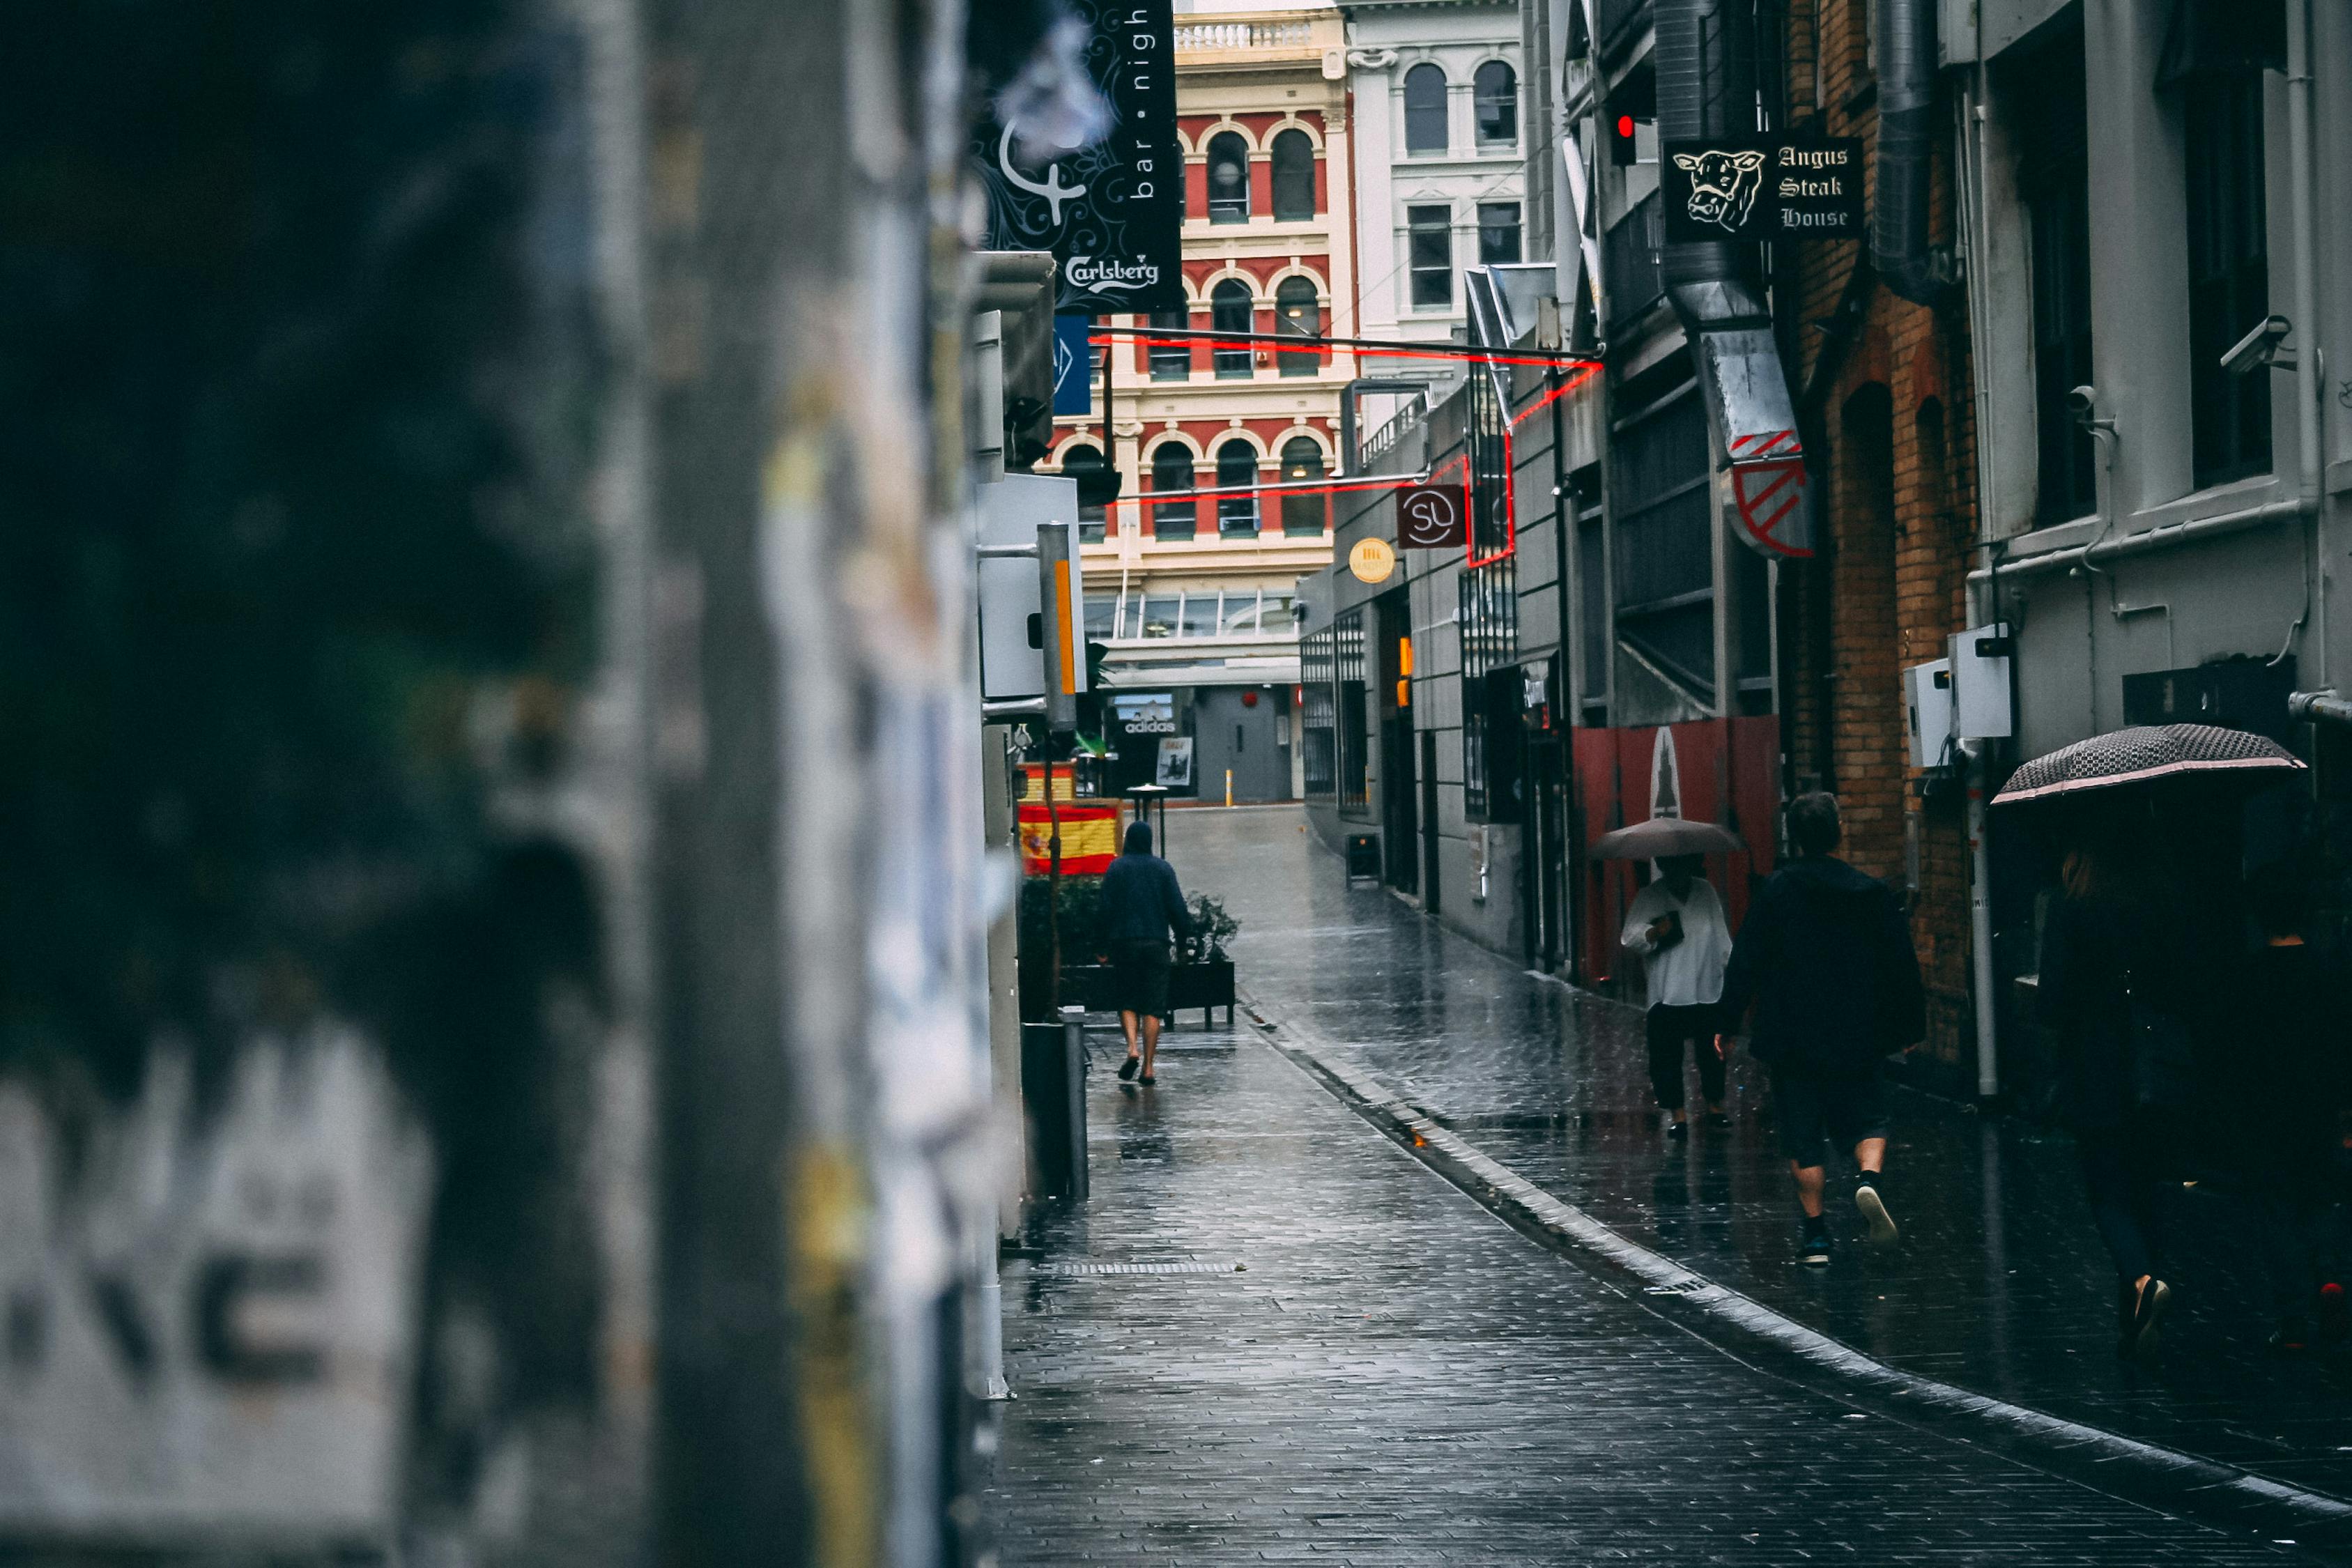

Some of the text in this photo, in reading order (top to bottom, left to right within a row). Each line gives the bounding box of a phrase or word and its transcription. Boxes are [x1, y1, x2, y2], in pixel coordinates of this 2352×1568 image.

[1123, 9, 1156, 199] bar nigh
[1778, 146, 1848, 169] Angus
[1778, 176, 1843, 199] Steak
[1780, 208, 1848, 231] House
[1065, 254, 1159, 288] Carlsberg
[1125, 718, 1176, 734] adidas
